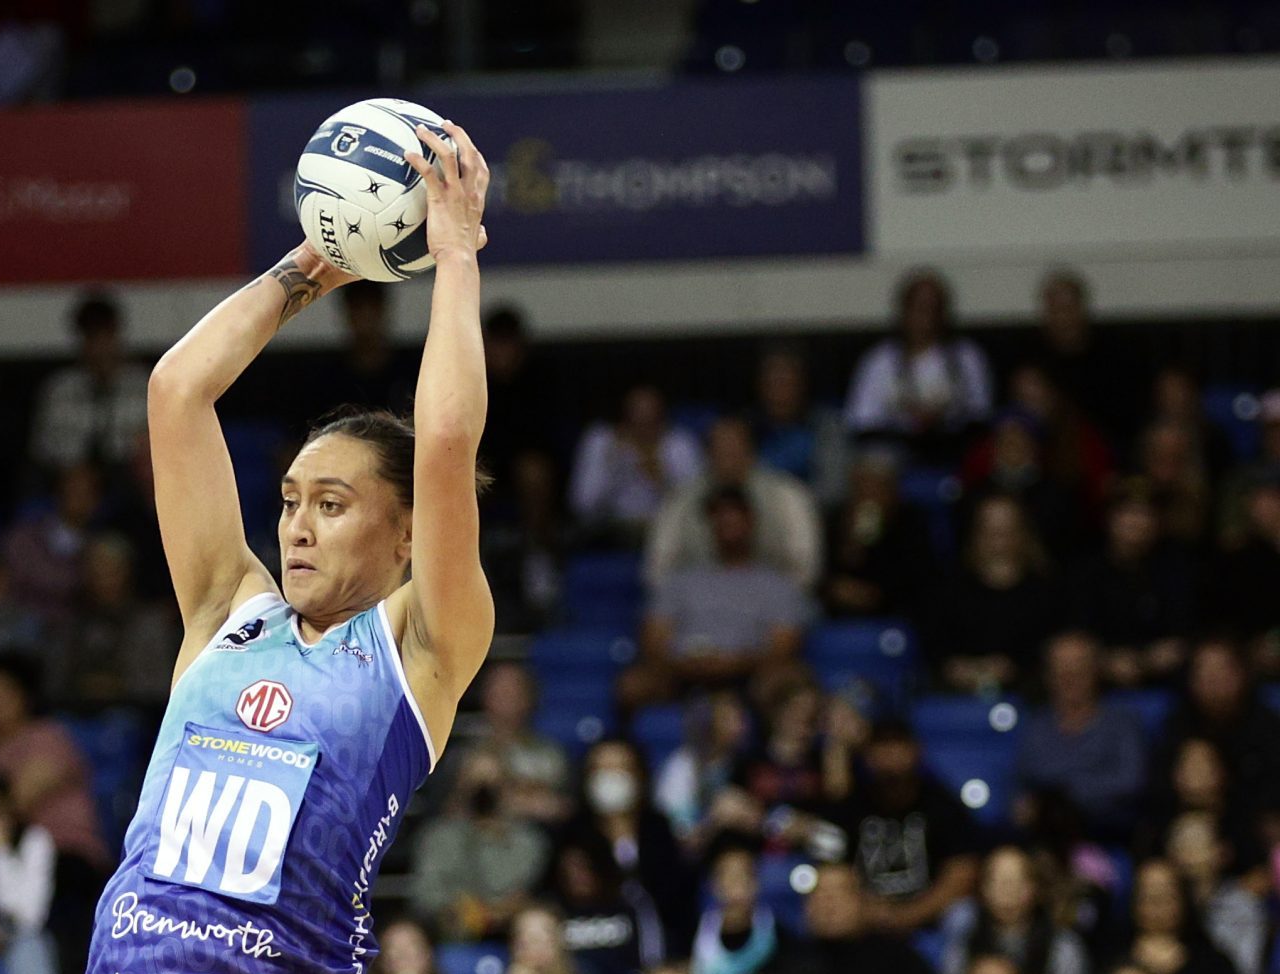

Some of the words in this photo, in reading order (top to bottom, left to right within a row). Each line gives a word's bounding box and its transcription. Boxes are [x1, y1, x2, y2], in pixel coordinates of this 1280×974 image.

[558, 153, 837, 211] THOMPSON
[240, 684, 289, 728] MG
[187, 735, 312, 769] STONEWOOD
[217, 754, 264, 769] HOMES
[153, 766, 292, 894] WD
[111, 891, 282, 958] Bremworth
